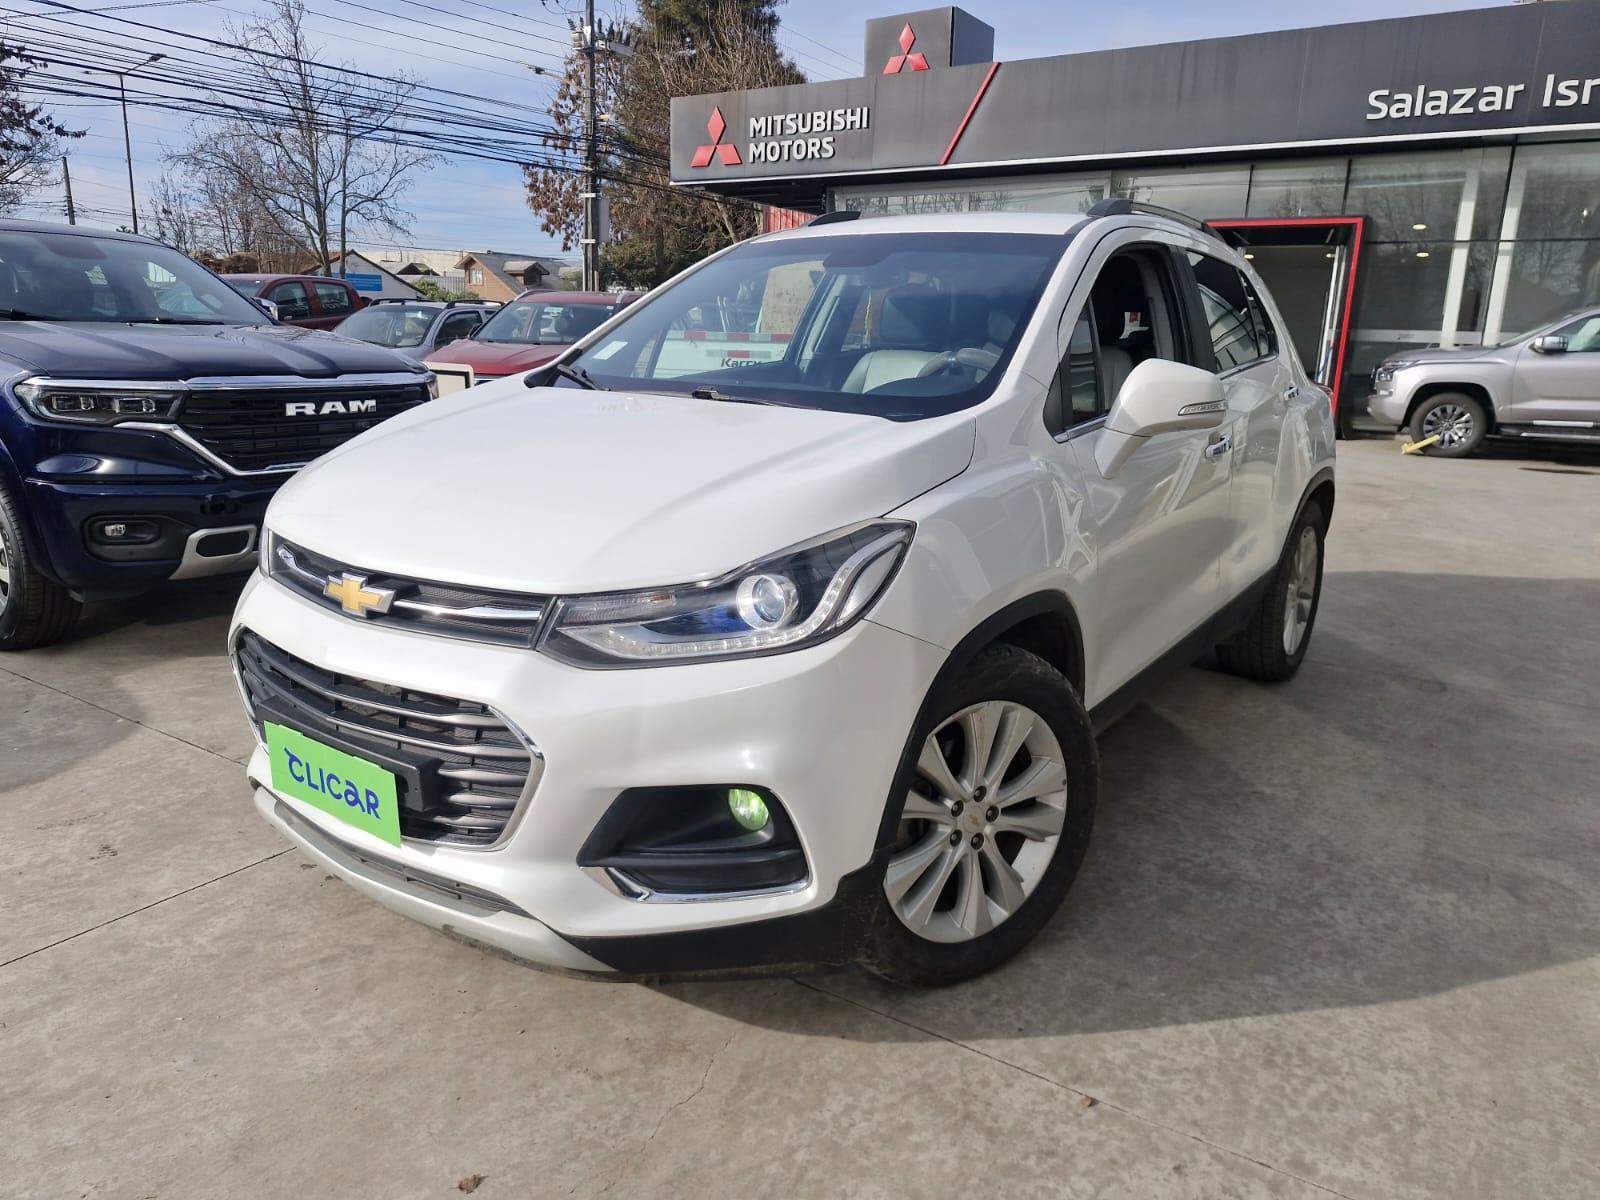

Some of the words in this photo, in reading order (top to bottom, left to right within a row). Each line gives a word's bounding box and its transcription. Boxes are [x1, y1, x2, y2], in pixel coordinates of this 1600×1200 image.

[1366, 83, 1525, 120] Salazar
[1542, 73, 1600, 107] Isr
[749, 106, 869, 138] MITSUBISHI
[749, 136, 834, 163] MOTORS
[285, 399, 377, 416] RAM
